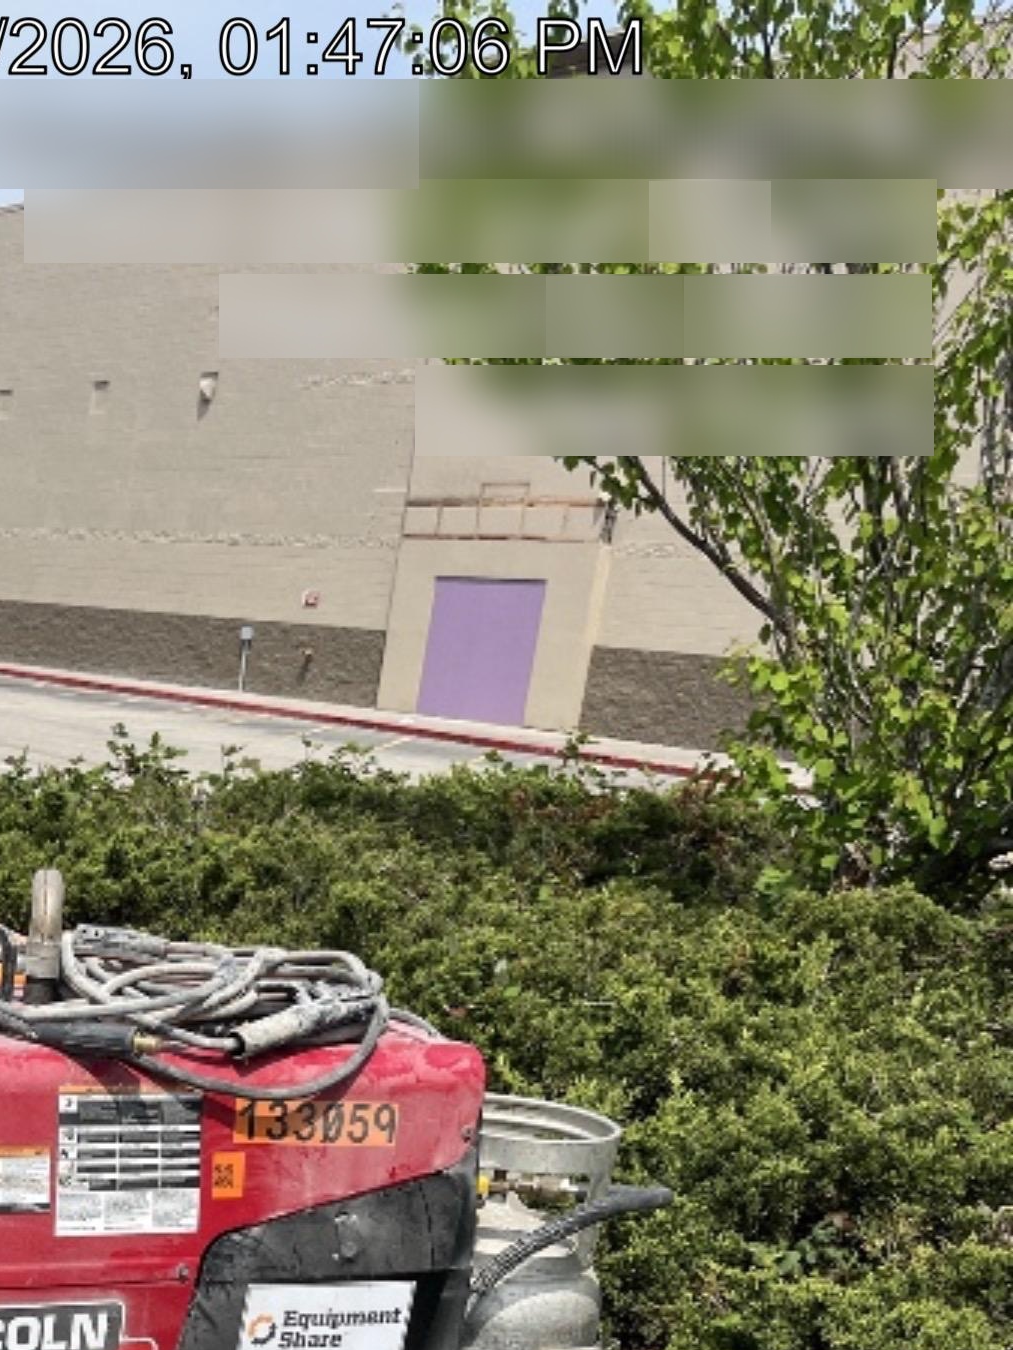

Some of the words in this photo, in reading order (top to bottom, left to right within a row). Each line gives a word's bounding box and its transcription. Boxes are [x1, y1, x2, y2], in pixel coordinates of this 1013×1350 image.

[239, 1100, 396, 1143] 133059
[283, 1308, 402, 1329] Equipment
[278, 1331, 342, 1349] Share
